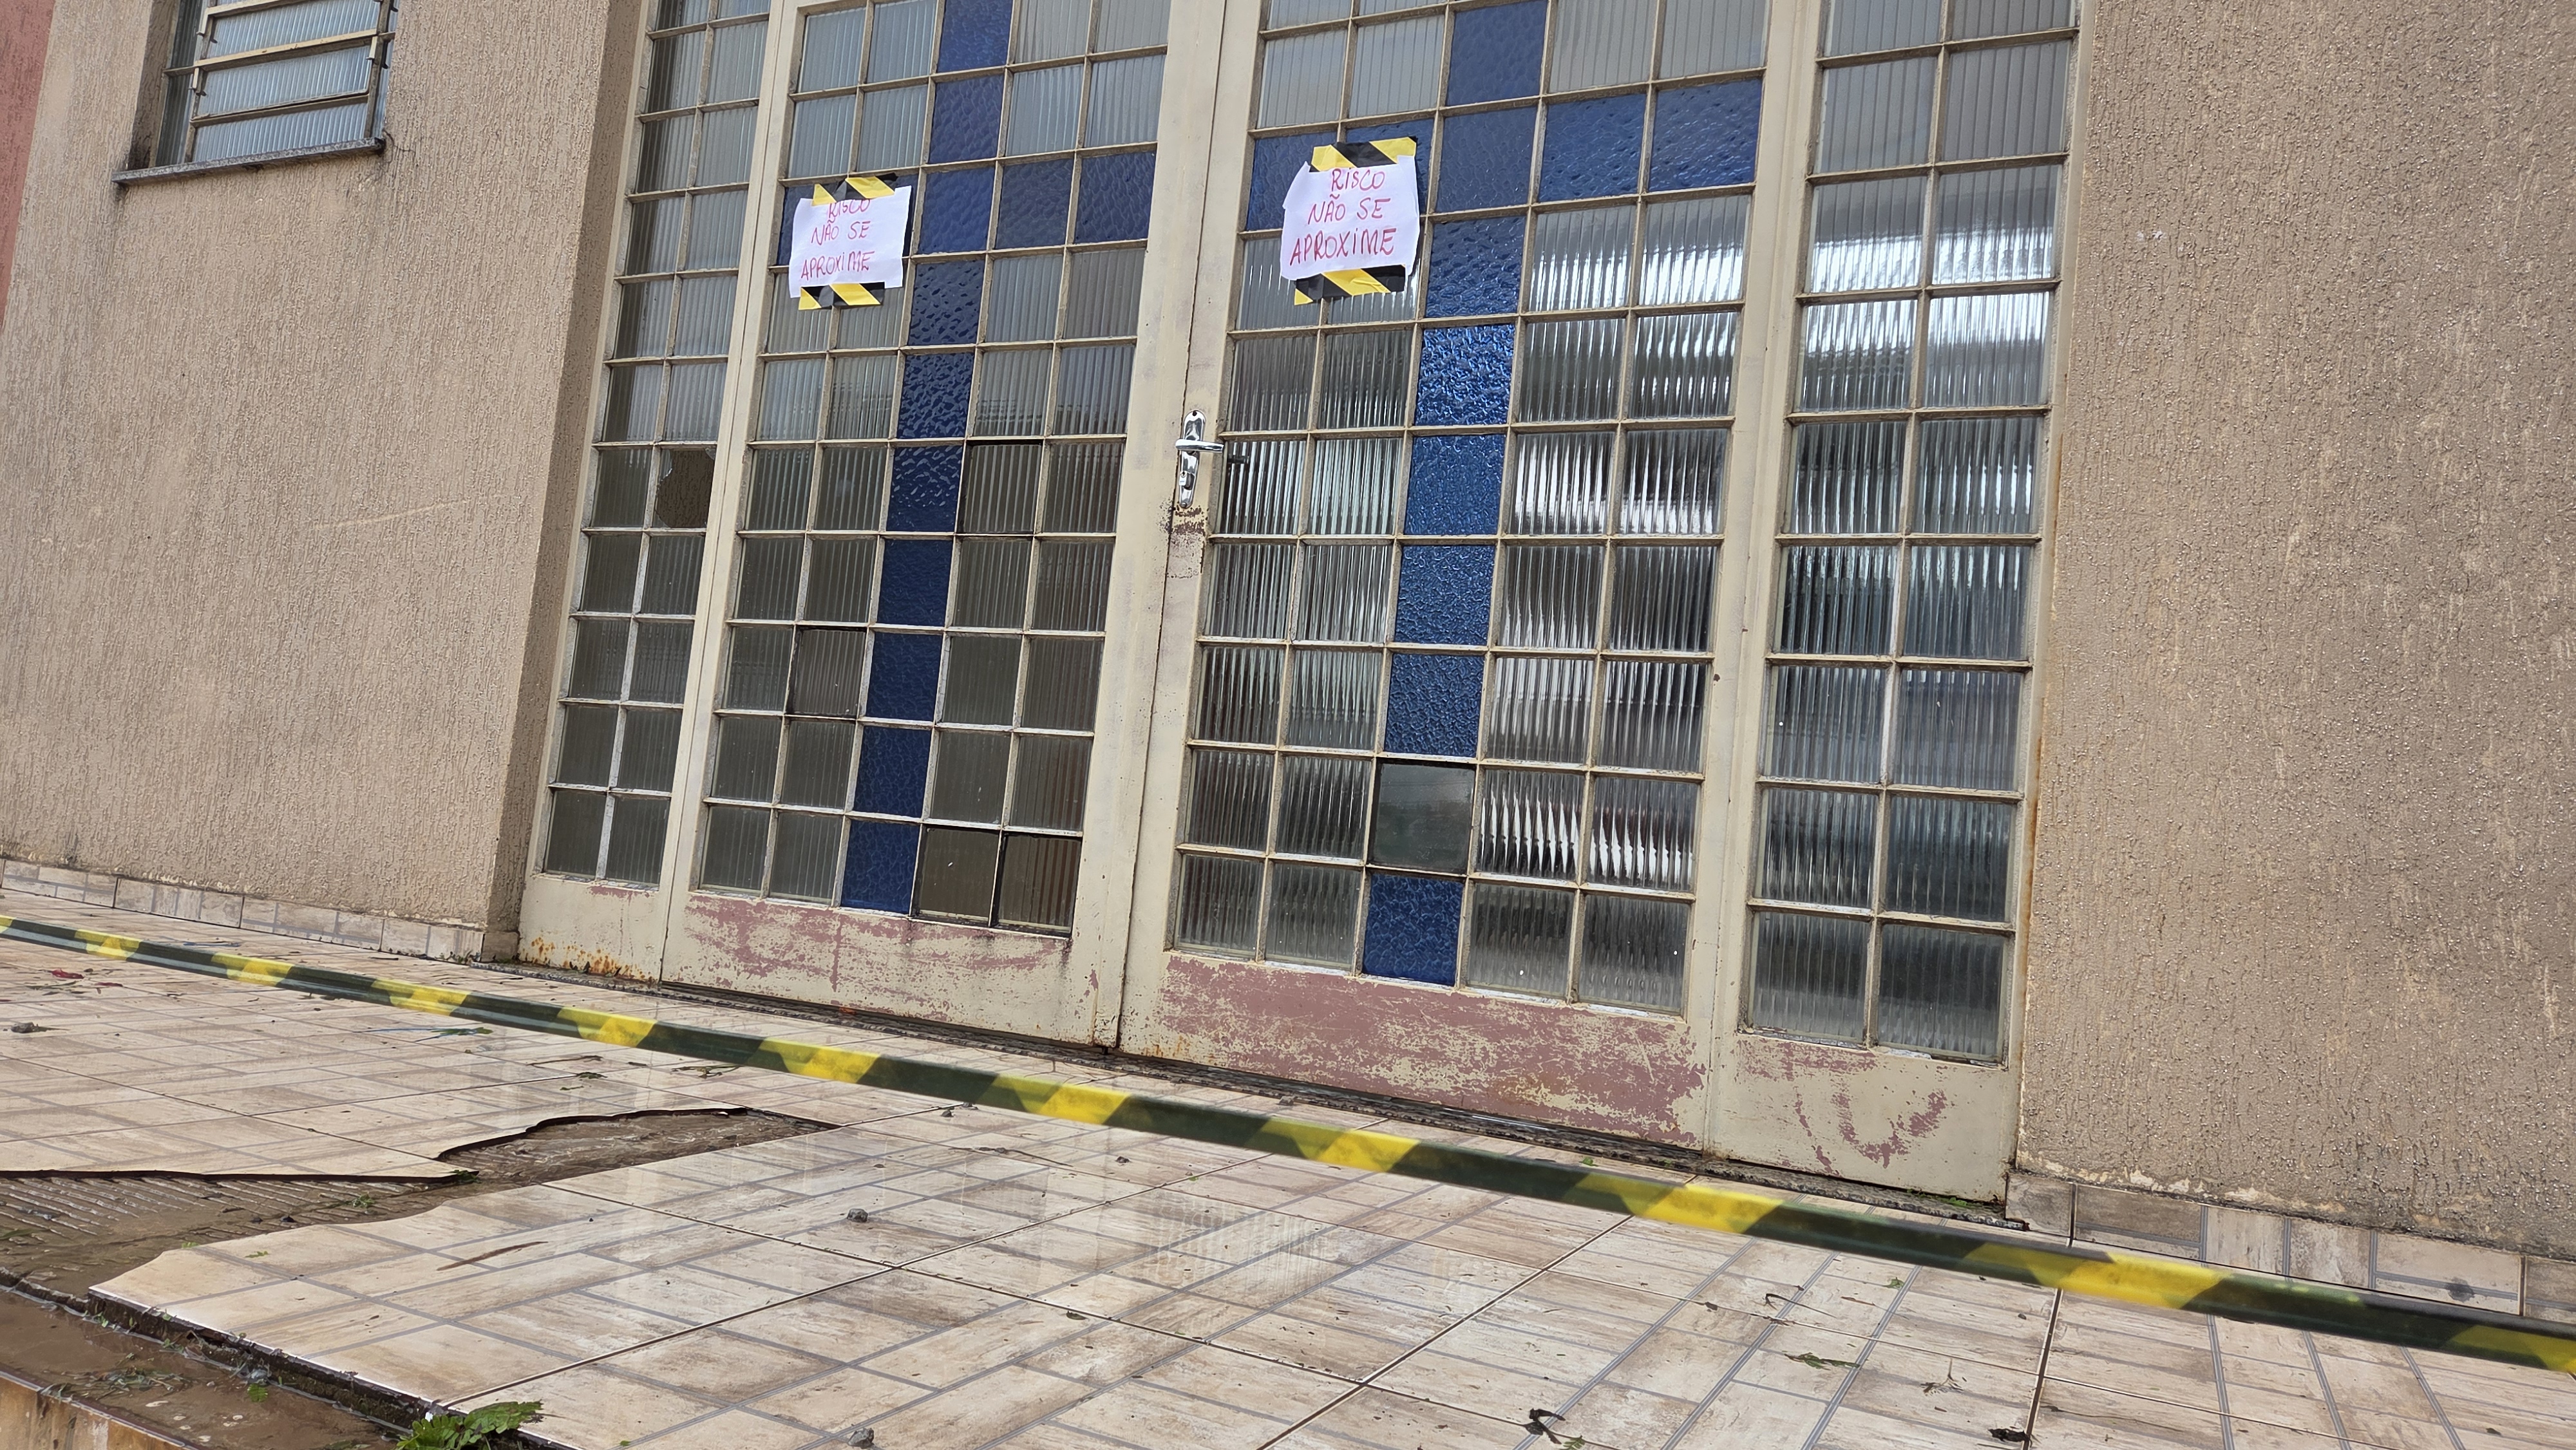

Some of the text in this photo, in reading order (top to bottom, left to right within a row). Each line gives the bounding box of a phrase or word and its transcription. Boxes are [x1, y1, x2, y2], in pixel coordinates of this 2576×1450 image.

[1331, 167, 1385, 192] RISCO
[828, 199, 870, 219] RISCO
[1307, 193, 1391, 225] NÃO SE
[811, 217, 871, 245] NÃO SE
[1289, 227, 1396, 266] APROXIME
[800, 250, 875, 281] APROXIME
